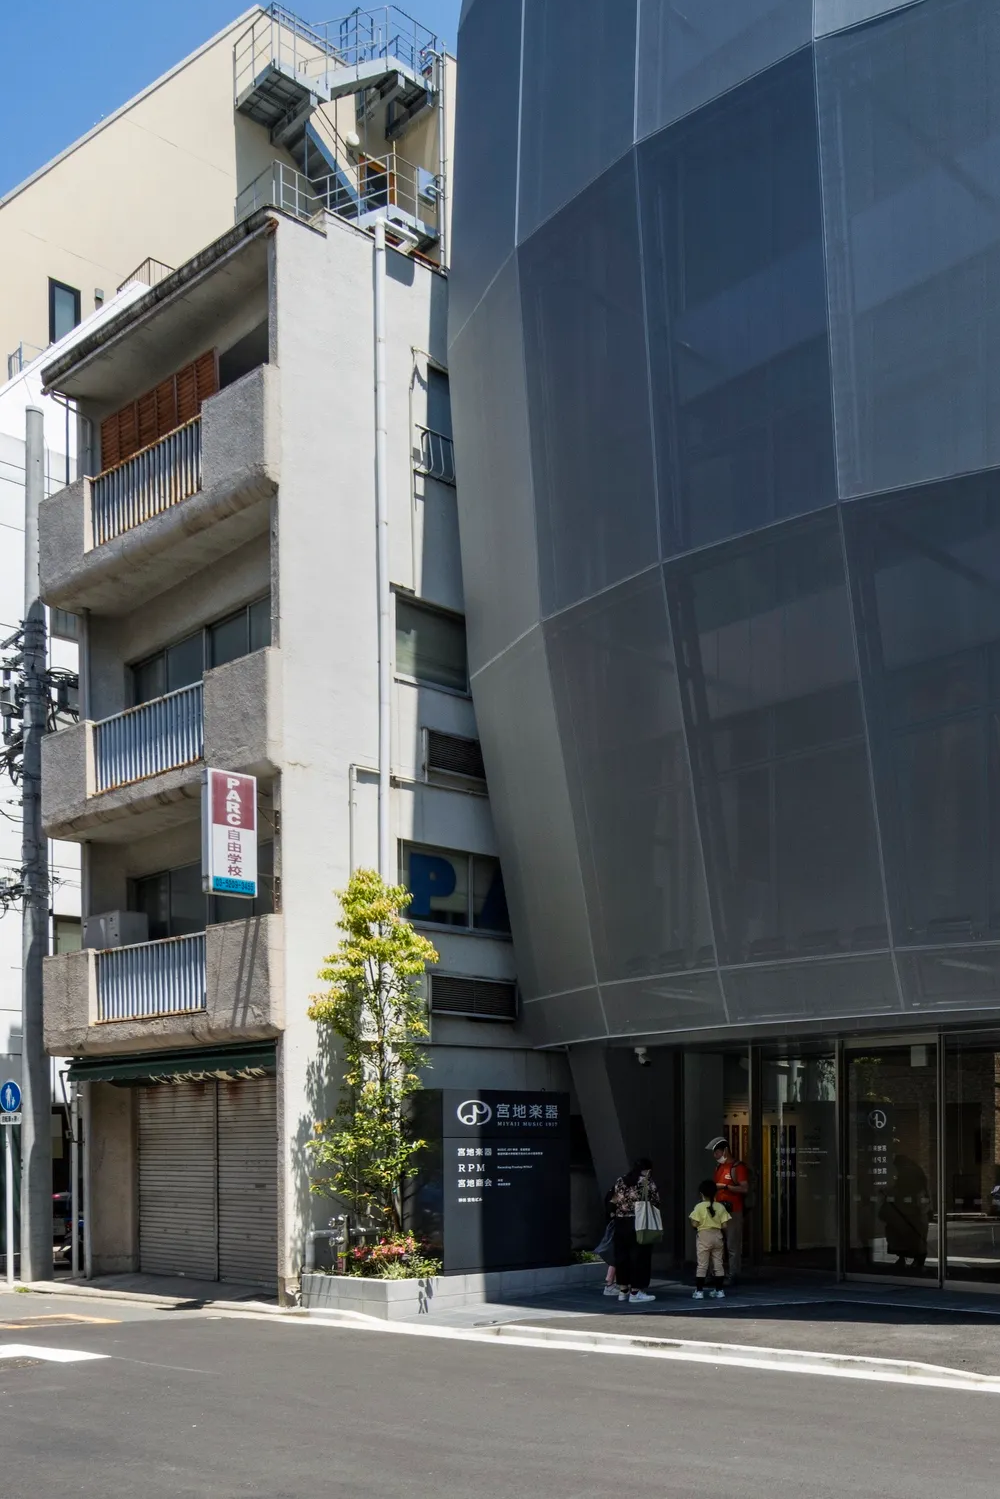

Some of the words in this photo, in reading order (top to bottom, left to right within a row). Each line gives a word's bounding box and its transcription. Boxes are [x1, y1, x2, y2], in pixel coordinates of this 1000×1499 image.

[226, 777, 242, 826] PARC
[227, 829, 242, 877] 自由学校
[496, 1103, 559, 1119] 宮地楽器
[457, 1148, 492, 1156] 宮地楽器
[458, 1164, 485, 1172] RPM
[458, 1179, 492, 1188] 宮地商会
